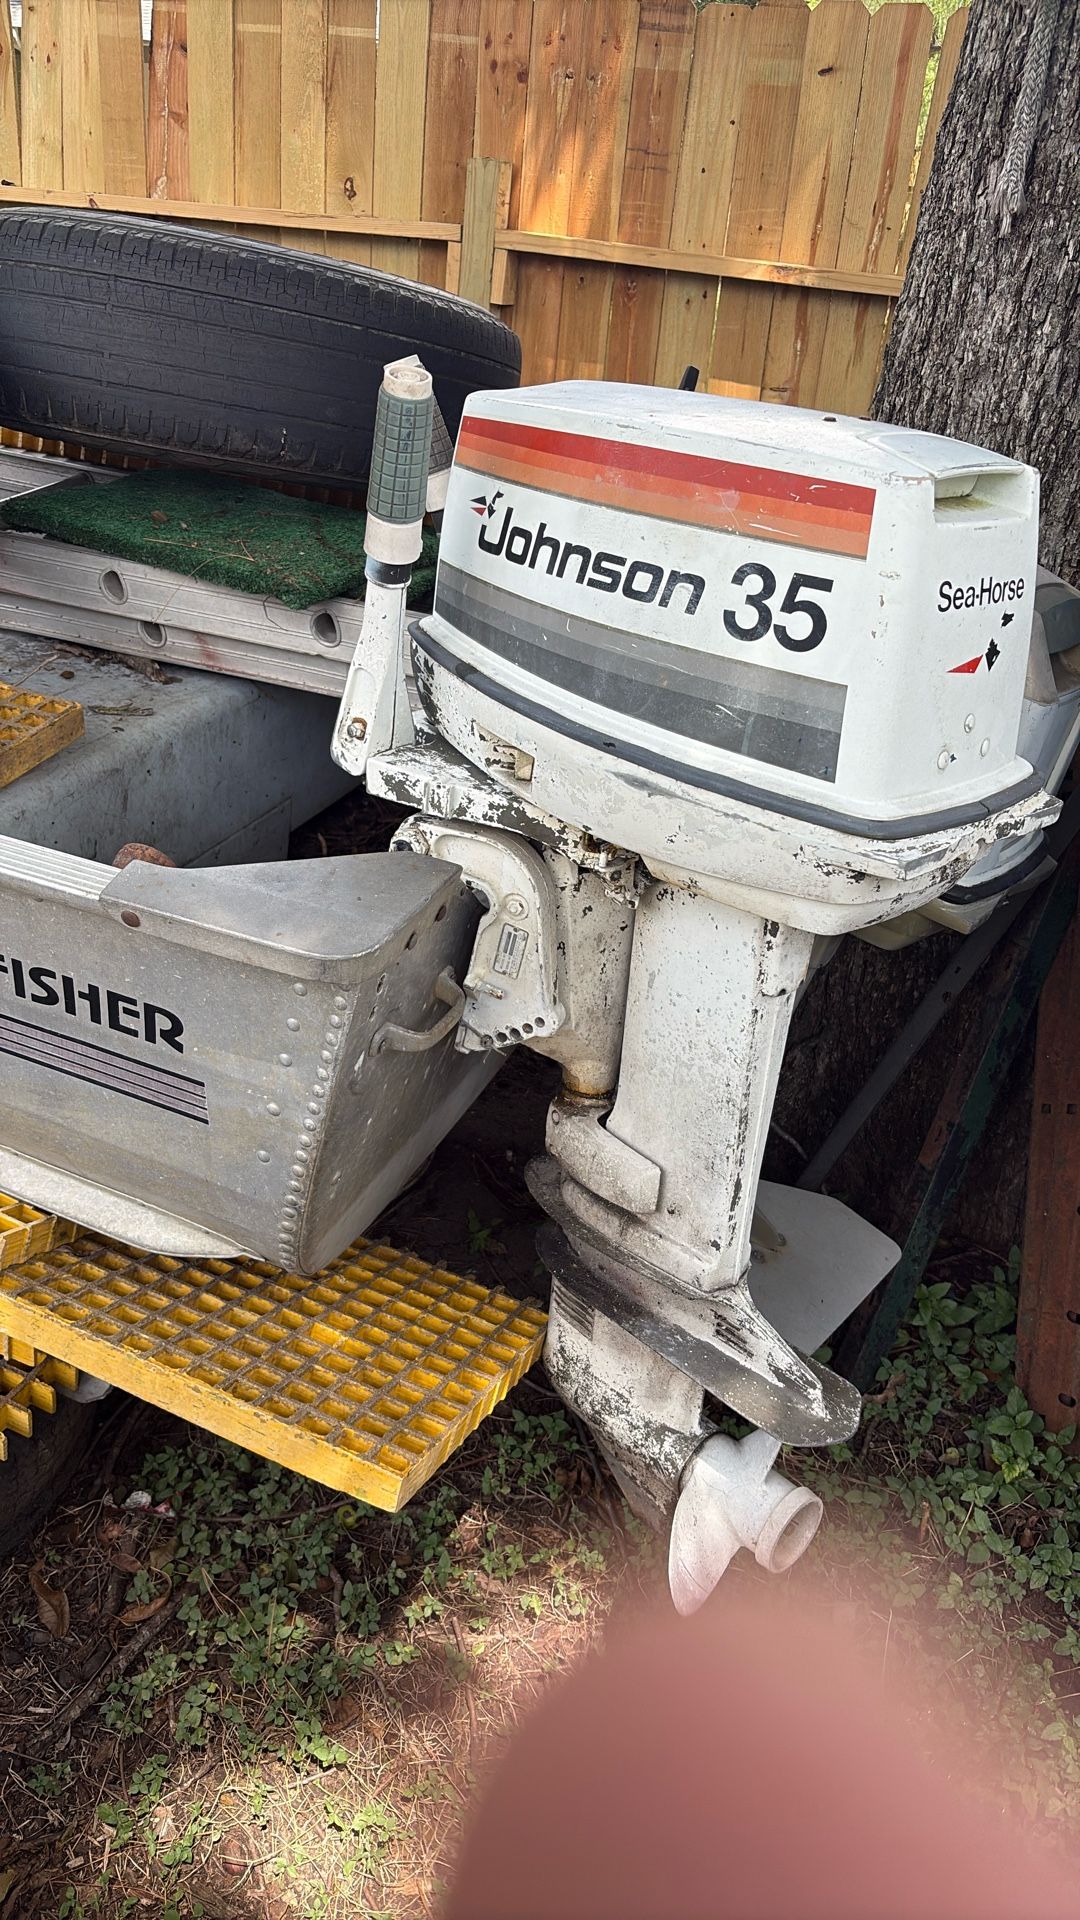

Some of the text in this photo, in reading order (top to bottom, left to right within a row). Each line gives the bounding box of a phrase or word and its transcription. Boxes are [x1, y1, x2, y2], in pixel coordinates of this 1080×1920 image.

[478, 507, 834, 653] Johnson 35
[937, 576, 1025, 613] Sea-Horse
[0, 954, 184, 1054] ISHER
